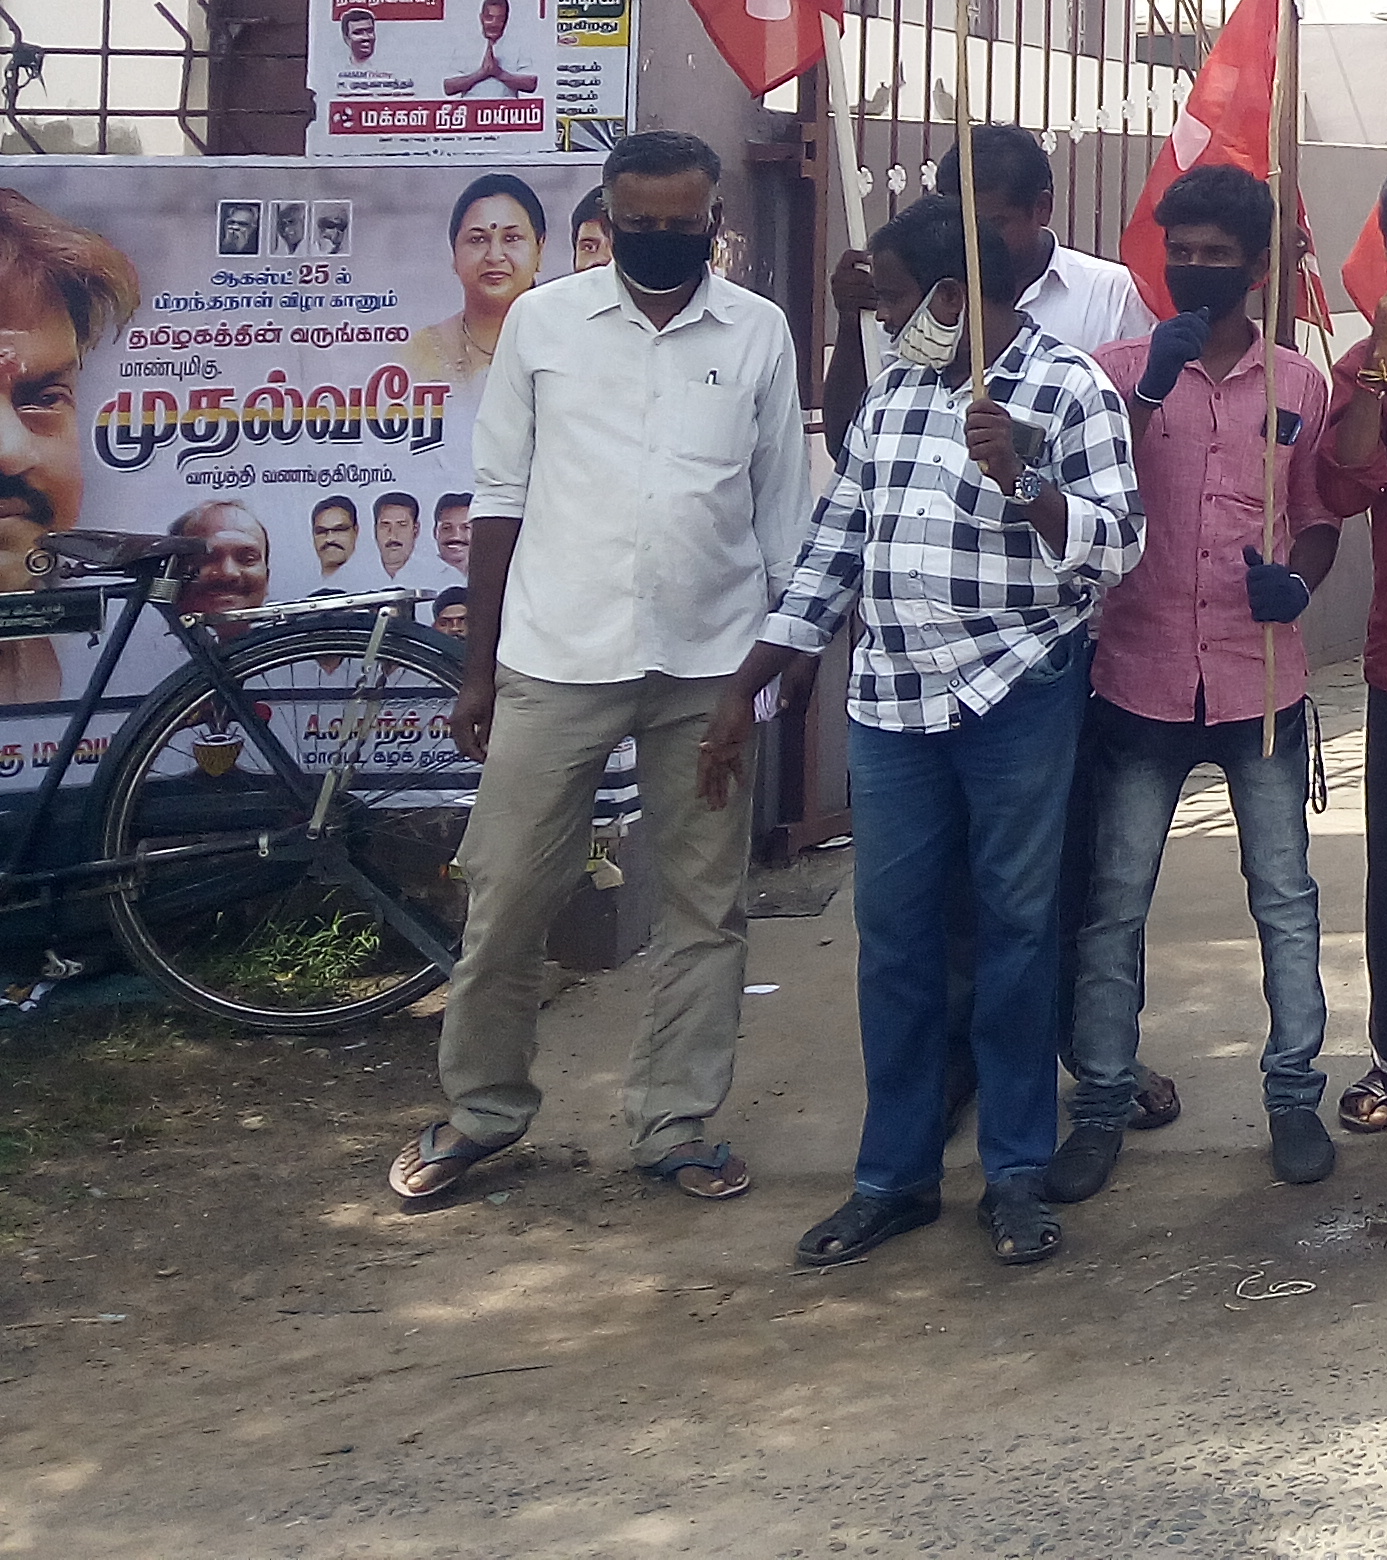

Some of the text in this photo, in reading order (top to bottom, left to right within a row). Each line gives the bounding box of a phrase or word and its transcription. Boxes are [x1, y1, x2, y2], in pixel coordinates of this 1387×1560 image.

[361, 104, 542, 129] மக்கள் நீதி மய்யம்
[210, 263, 352, 288] ஆகஸ்ட் 25 ல்
[153, 289, 398, 313] பிறந்தநாள் விழா காணும்
[128, 321, 410, 351] தமிழகத்தின் வருங்கால
[119, 355, 223, 382] மாண்புமிகு.
[95, 363, 452, 472] முதல்வரே
[185, 464, 256, 489] வாழ்த்தி
